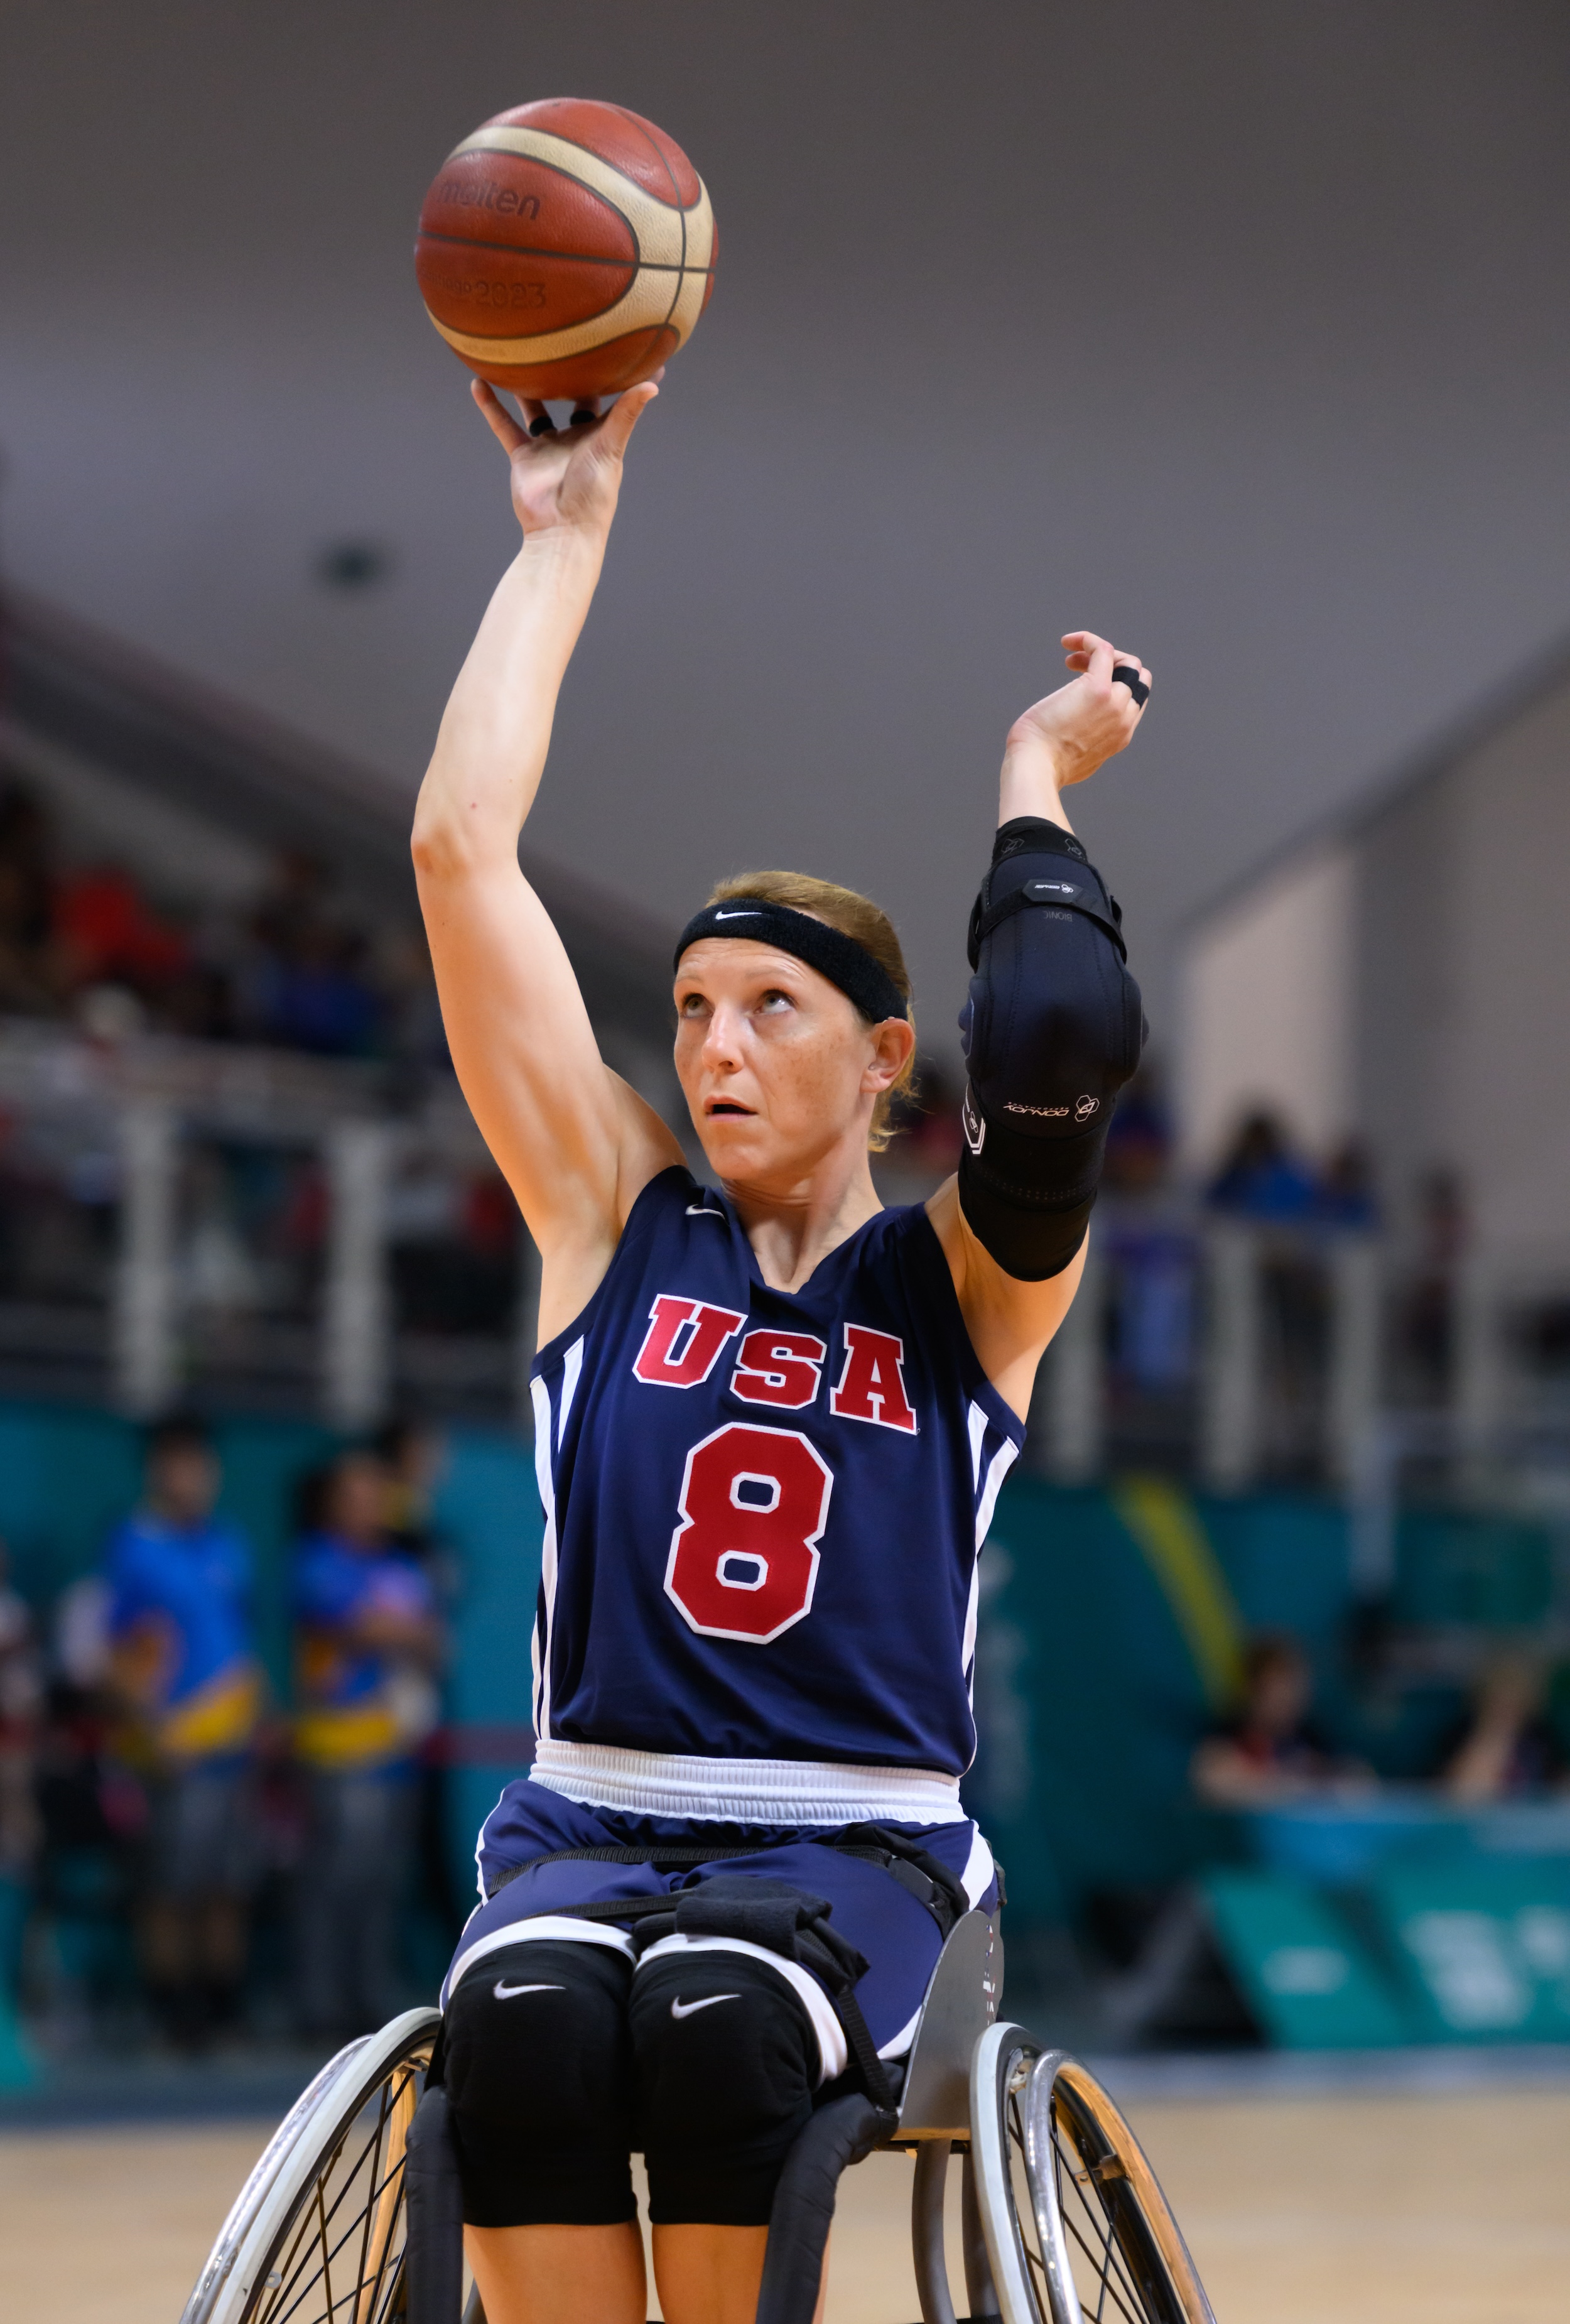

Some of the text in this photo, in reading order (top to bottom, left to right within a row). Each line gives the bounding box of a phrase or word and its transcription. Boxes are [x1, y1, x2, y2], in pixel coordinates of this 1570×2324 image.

[437, 178, 540, 220] molten
[474, 281, 546, 308] 2023
[1042, 910, 1073, 922] BIONIC
[1004, 1105, 1069, 1116] DONJOY
[632, 1294, 917, 1435] USA
[663, 1421, 834, 1644] 8
